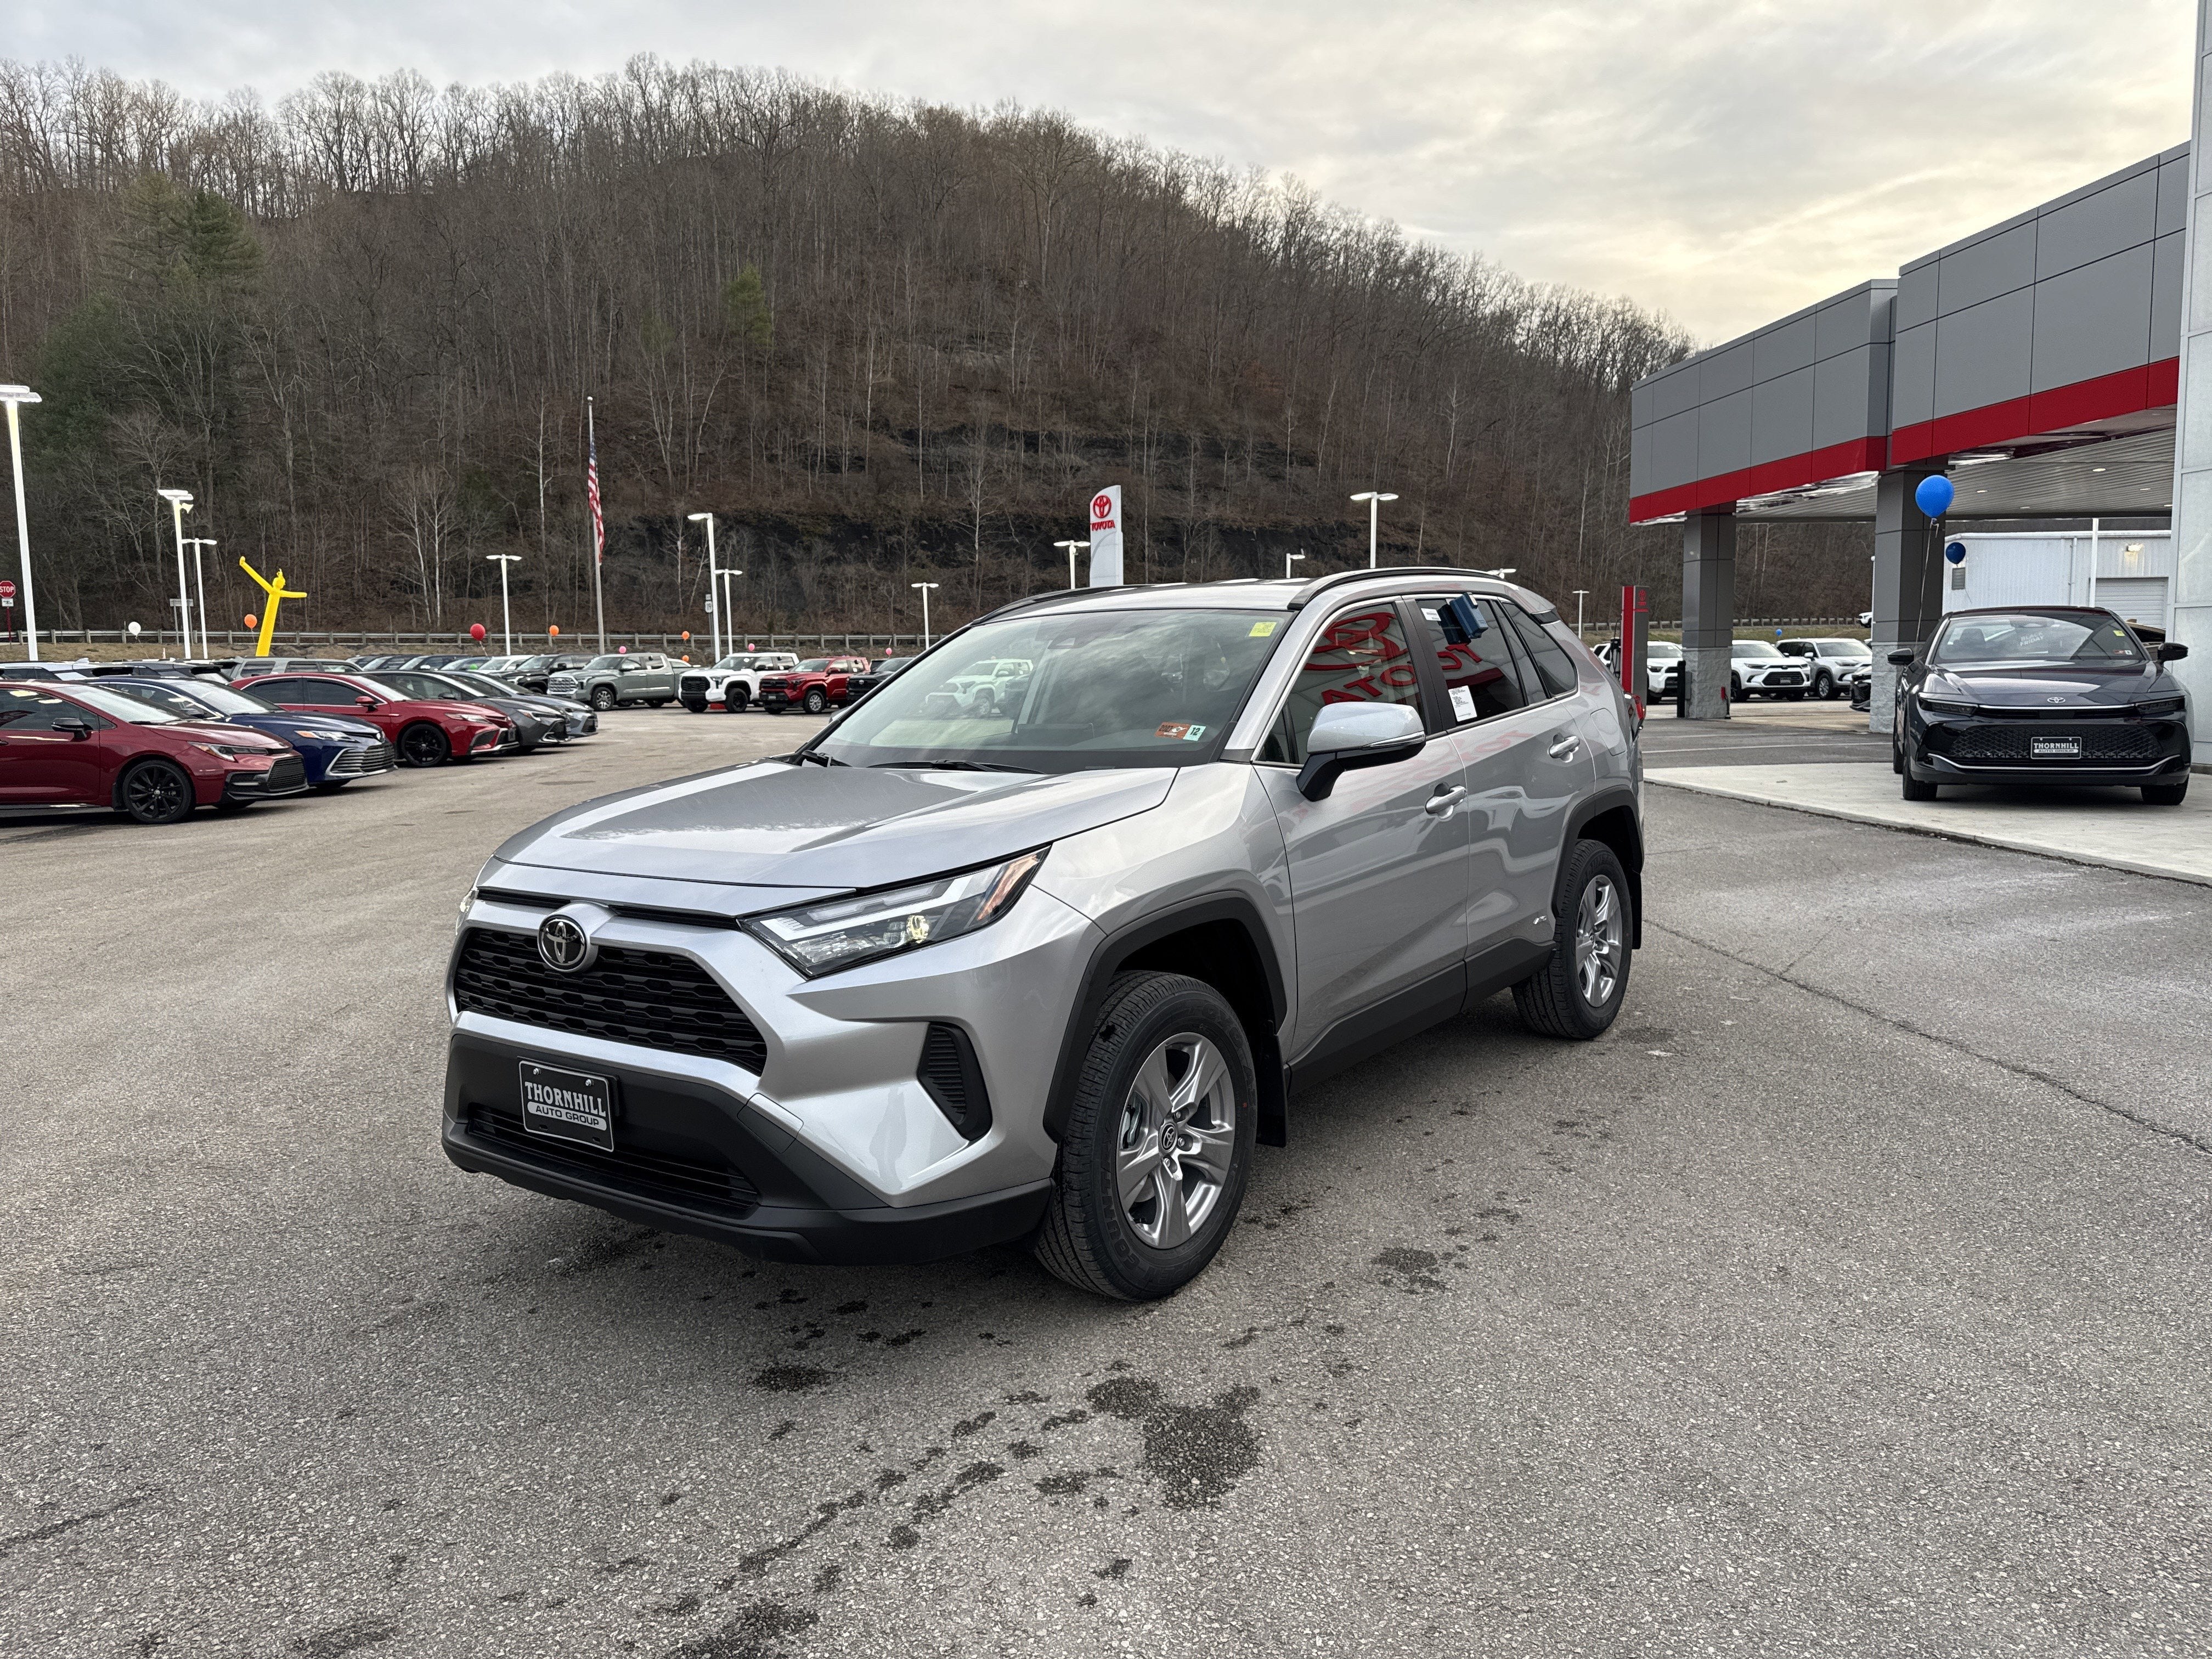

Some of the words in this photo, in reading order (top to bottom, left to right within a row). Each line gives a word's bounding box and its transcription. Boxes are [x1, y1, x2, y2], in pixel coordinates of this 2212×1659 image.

[1090, 520, 1115, 532] TOYOTA
[2020, 635, 2044, 646] FRIDAY
[525, 1081, 606, 1117] THORNHILL
[535, 1105, 562, 1118] AUTO
[565, 1111, 599, 1126] GROUP
